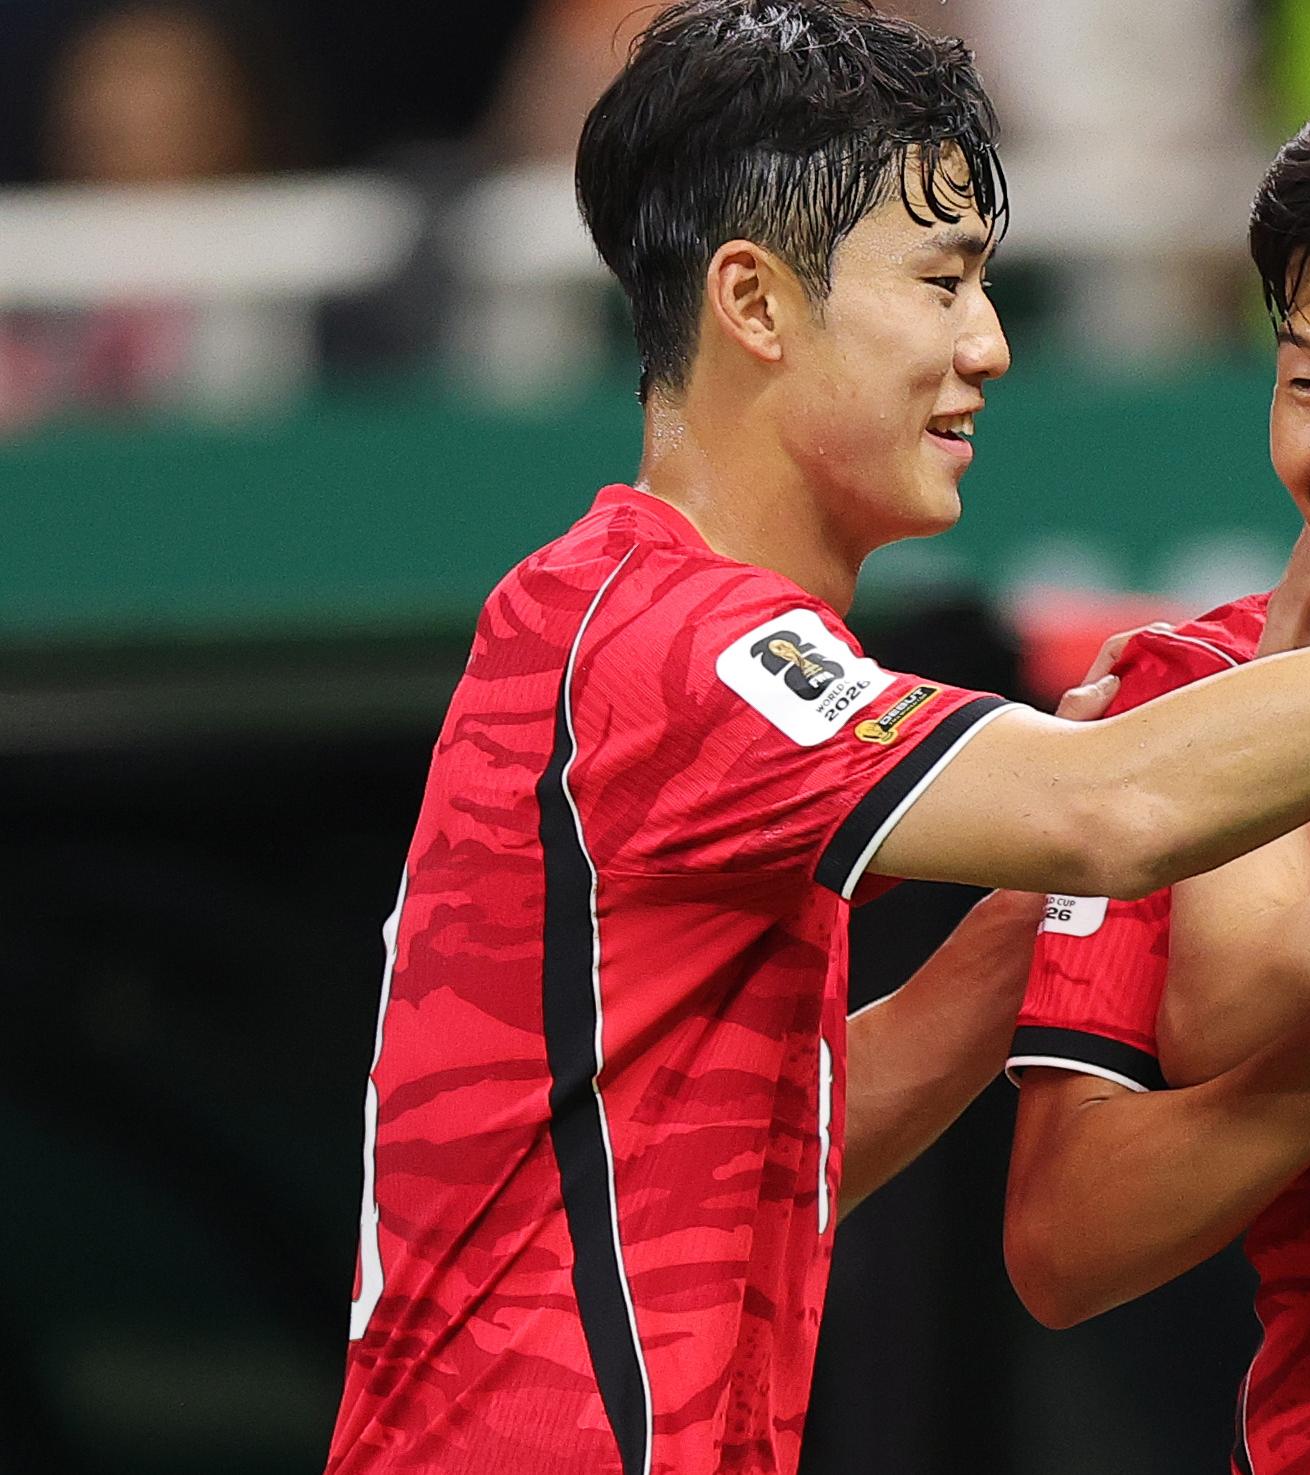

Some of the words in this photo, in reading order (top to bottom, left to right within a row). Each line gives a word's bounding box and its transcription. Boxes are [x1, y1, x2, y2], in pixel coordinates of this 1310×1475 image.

[816, 683, 845, 713] WORLD
[824, 680, 871, 722] 2026
[880, 688, 924, 726] DEBUT
[1046, 907, 1072, 921] 26
[1057, 898, 1076, 907] CUP
